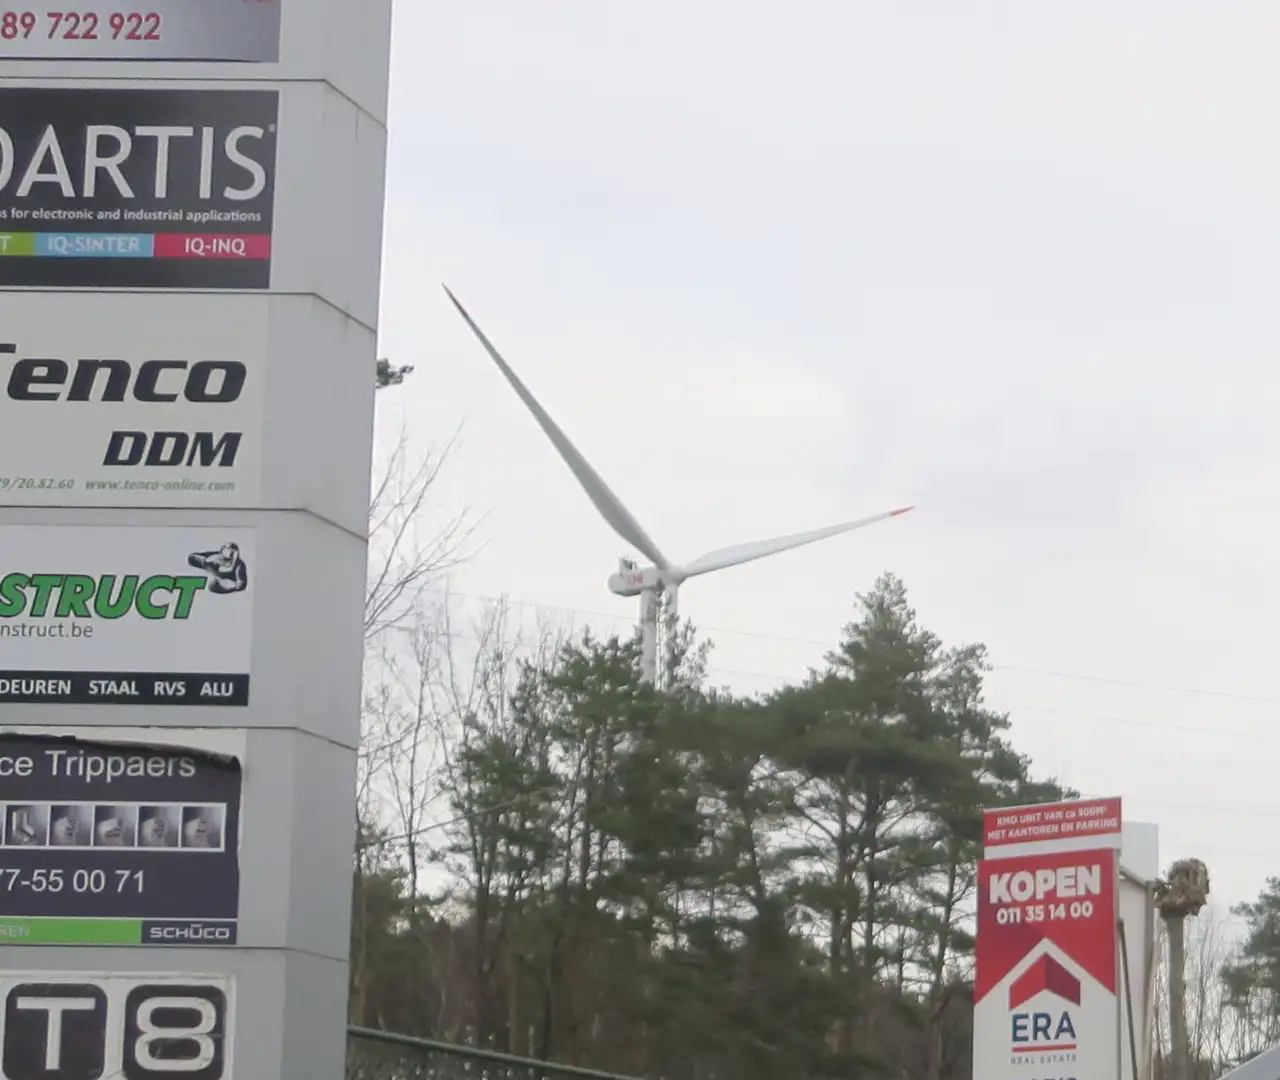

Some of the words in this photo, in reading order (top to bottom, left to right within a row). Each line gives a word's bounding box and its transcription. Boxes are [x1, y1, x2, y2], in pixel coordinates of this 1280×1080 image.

[47, 12, 98, 40] 722
[109, 13, 161, 40] 922
[0, 124, 266, 200] ARTIS
[11, 207, 29, 219] for
[32, 208, 93, 220] electronic
[97, 209, 120, 220] and
[124, 209, 183, 222] industrial
[186, 210, 262, 224] applications
[184, 237, 246, 256] IQ-INQ
[102, 431, 243, 467] DDM
[0, 476, 75, 492] 9/20.82.60
[0, 572, 208, 620] STRUCT
[88, 680, 139, 697] STAAL
[153, 681, 186, 697] RVS
[200, 682, 233, 698] ALU
[45, 750, 196, 783] Trippaers
[1044, 809, 1062, 821] VAN
[987, 829, 1005, 841] MET
[1007, 823, 1059, 838] KANTOREN
[1061, 821, 1075, 832] EN
[1076, 817, 1117, 831] PARKING
[0, 869, 64, 892] 7-55
[73, 869, 105, 893] 00
[115, 870, 145, 893] 71
[989, 864, 1101, 904] KOPEN
[996, 906, 1021, 925] 011
[1024, 904, 1045, 923] 35
[1048, 903, 1066, 920] 14
[1070, 900, 1093, 918] 00
[149, 924, 231, 941] SCHÜCO
[1011, 1010, 1077, 1042] ERA
